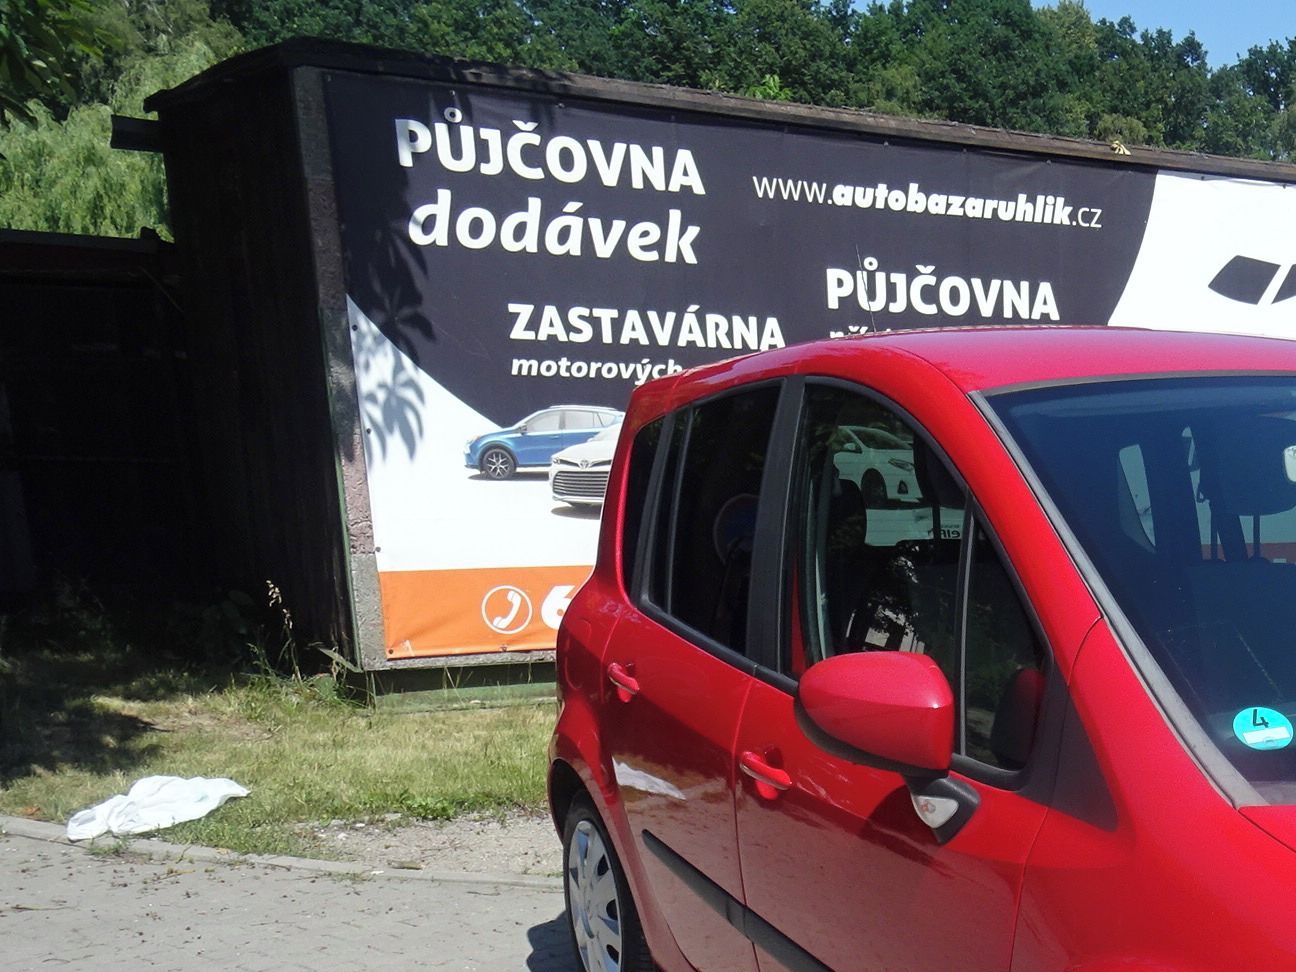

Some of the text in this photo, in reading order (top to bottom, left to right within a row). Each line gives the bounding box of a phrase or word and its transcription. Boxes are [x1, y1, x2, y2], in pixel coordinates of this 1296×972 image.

[395, 107, 706, 195] PŮJČOVNA
[408, 189, 701, 265] dodávek
[752, 175, 1103, 228] www.autobazaruhlik.cz
[826, 256, 1061, 321] PŮJČOVNA
[507, 304, 786, 352] ZASTAVÁRNA
[510, 356, 683, 386] motorových
[1252, 708, 1269, 728] 4
